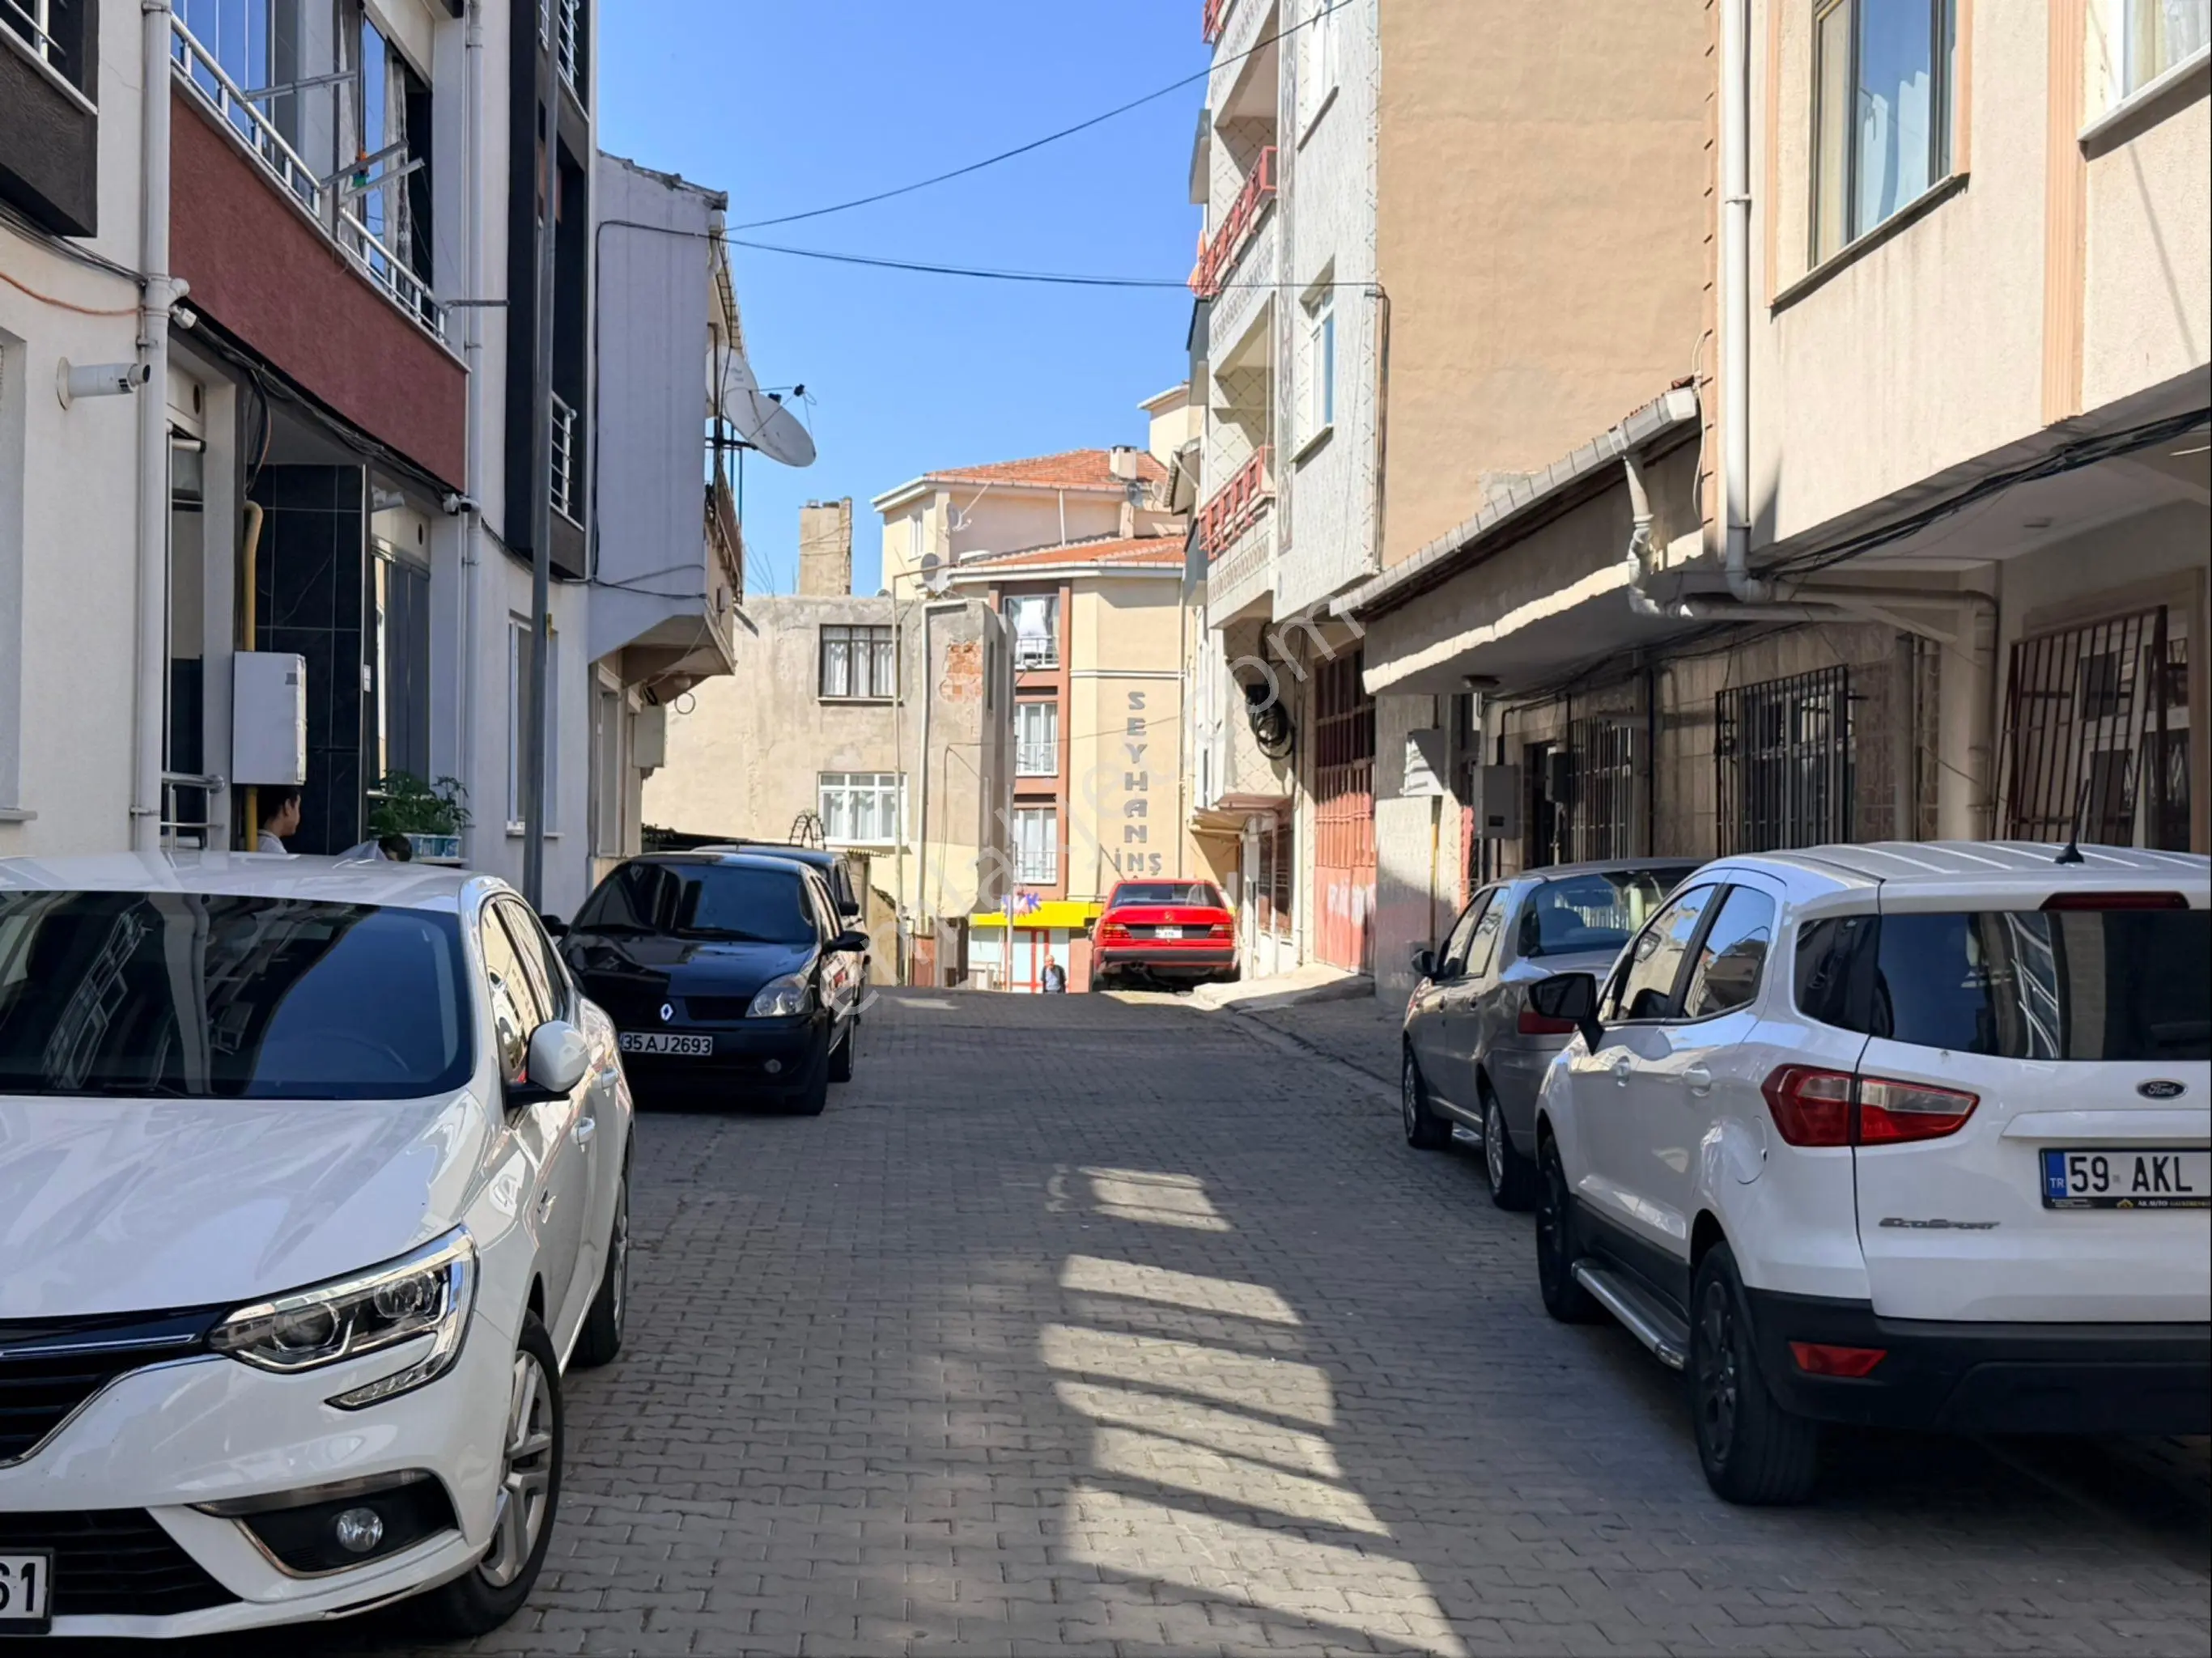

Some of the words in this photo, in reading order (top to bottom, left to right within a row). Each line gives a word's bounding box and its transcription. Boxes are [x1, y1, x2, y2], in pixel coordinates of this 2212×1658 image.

[1123, 691, 1148, 843] SEYHAN
[1114, 847, 1162, 876] İNŞ
[2049, 1177, 2065, 1189] TR
[2069, 1156, 2109, 1193] 59
[2131, 1156, 2193, 1193] AKL
